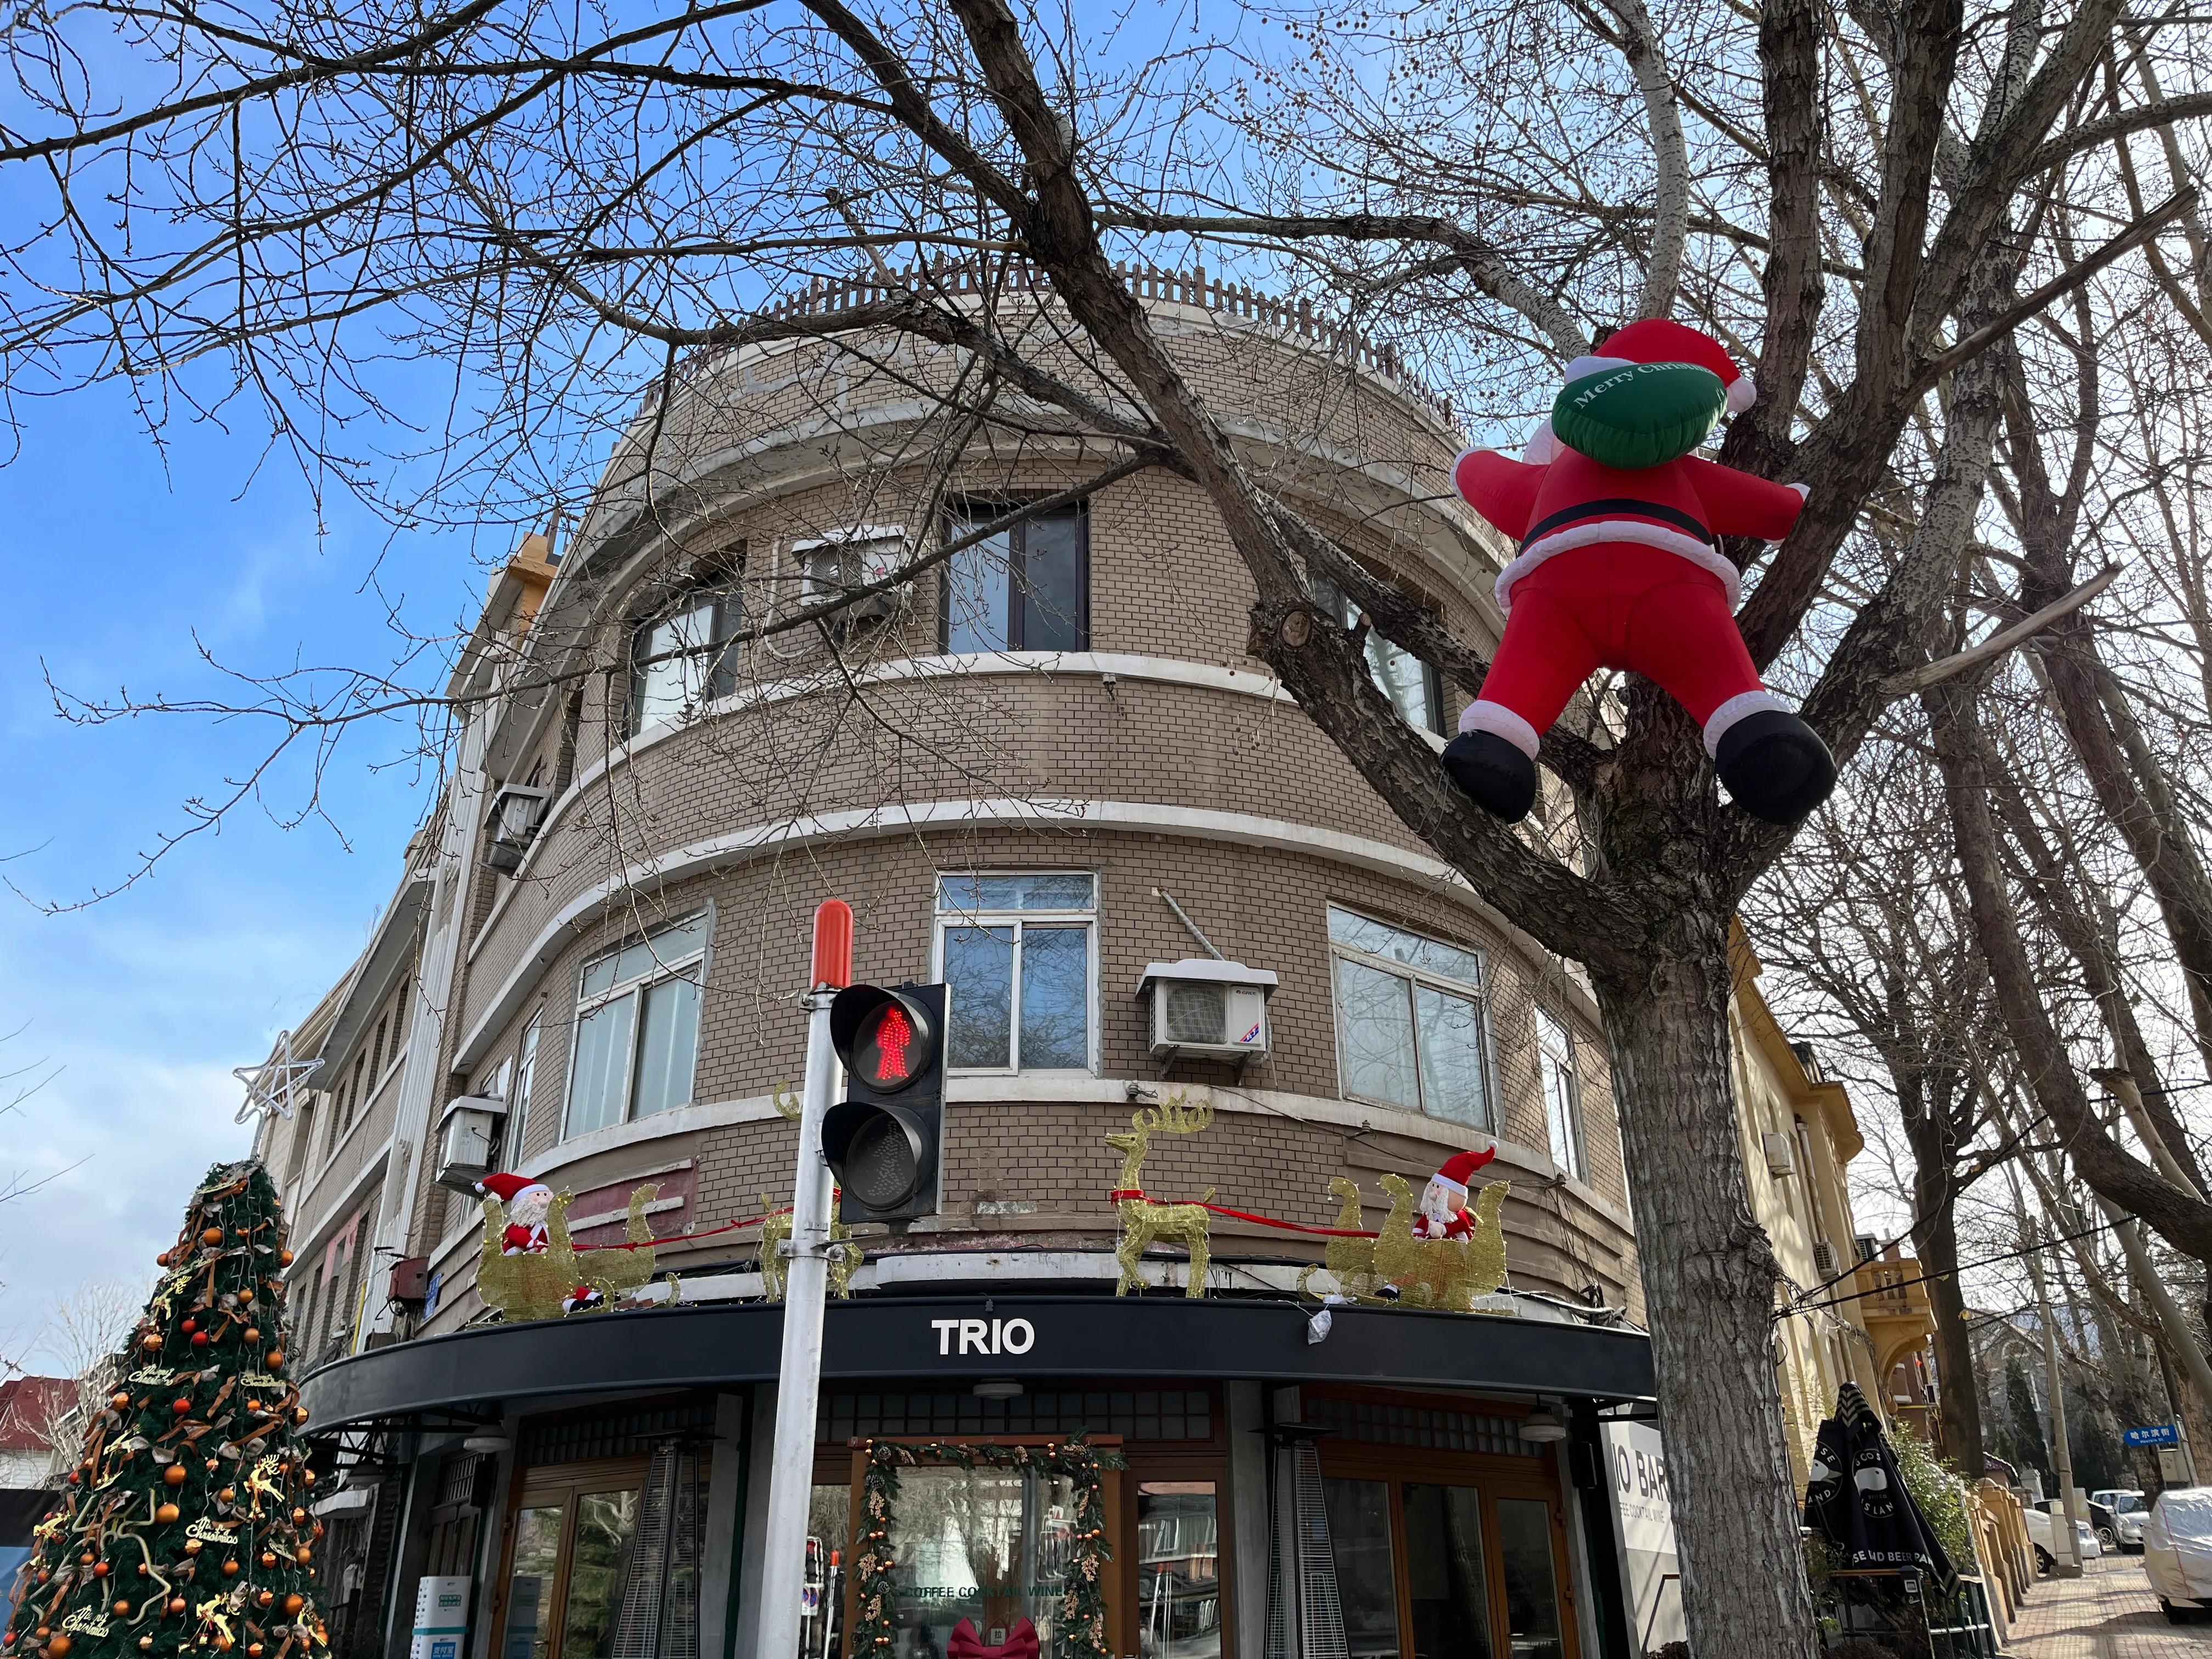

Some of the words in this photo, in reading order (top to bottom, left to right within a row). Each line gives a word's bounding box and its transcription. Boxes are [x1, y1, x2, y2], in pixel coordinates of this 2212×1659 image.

[1573, 370, 1634, 409] Merry
[931, 1318, 1035, 1355] TRIO
[2130, 1428, 2170, 1440] 哈尔滨街
[1635, 1450, 1671, 1503] BAR
[1629, 1504, 1653, 1522] COCKTAIL
[1653, 1508, 1664, 1523] WINE
[185, 1524, 238, 1544] Christmas
[1888, 1551, 1912, 1562] BEER
[905, 1587, 954, 1598] COFFEE
[958, 1587, 1023, 1598] COCKTAIL
[1028, 1586, 1063, 1596] WINE
[62, 1614, 109, 1638] Christmas
[995, 1630, 1002, 1639] 拉
